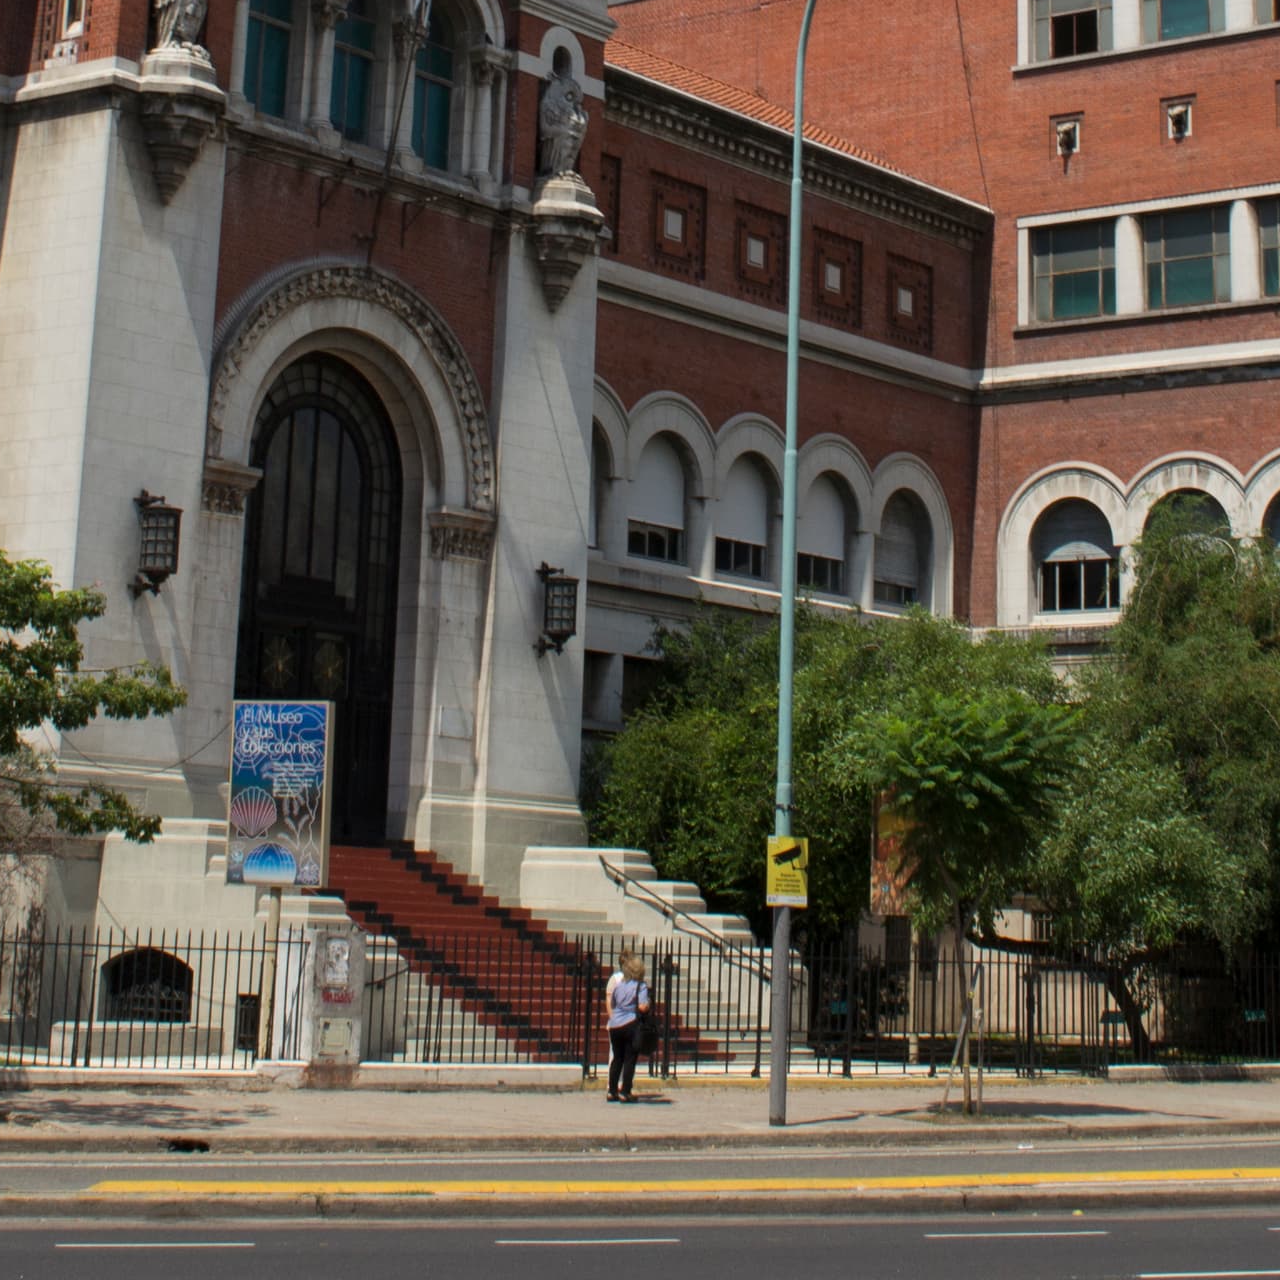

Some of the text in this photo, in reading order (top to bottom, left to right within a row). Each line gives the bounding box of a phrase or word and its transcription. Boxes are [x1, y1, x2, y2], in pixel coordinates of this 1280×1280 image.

[244, 708, 303, 724] El Museo
[242, 726, 275, 741] y sus
[242, 738, 316, 754] colecciones
